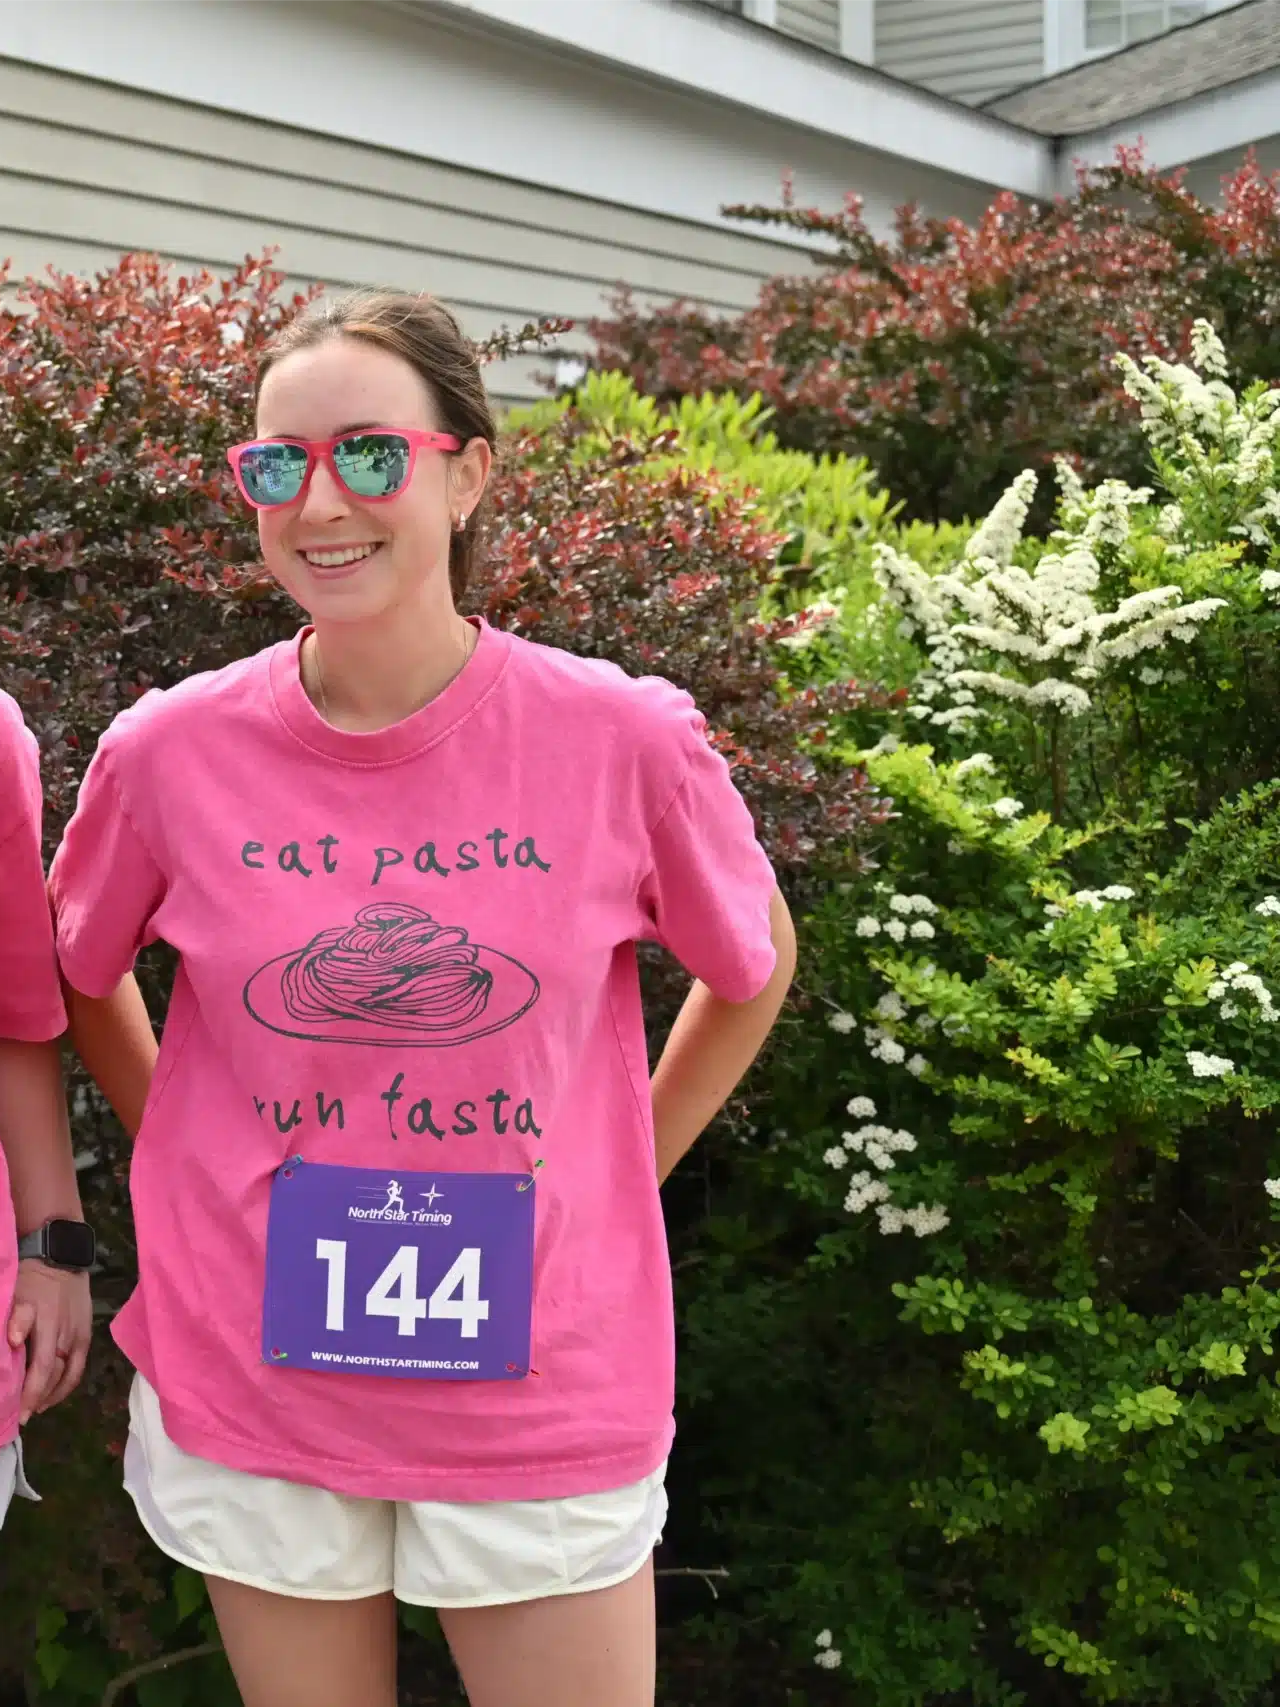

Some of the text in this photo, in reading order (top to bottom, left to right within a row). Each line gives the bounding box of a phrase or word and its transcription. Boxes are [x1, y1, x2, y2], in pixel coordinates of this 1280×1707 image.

[241, 828, 551, 886] eat pasta
[380, 1072, 542, 1141] fasta
[348, 1206, 381, 1219] North
[384, 1208, 410, 1221] Star
[412, 1208, 453, 1226] Timing
[316, 1238, 490, 1338] 144
[311, 1351, 479, 1370] WWW.NORTHSTARTIMING.COM
